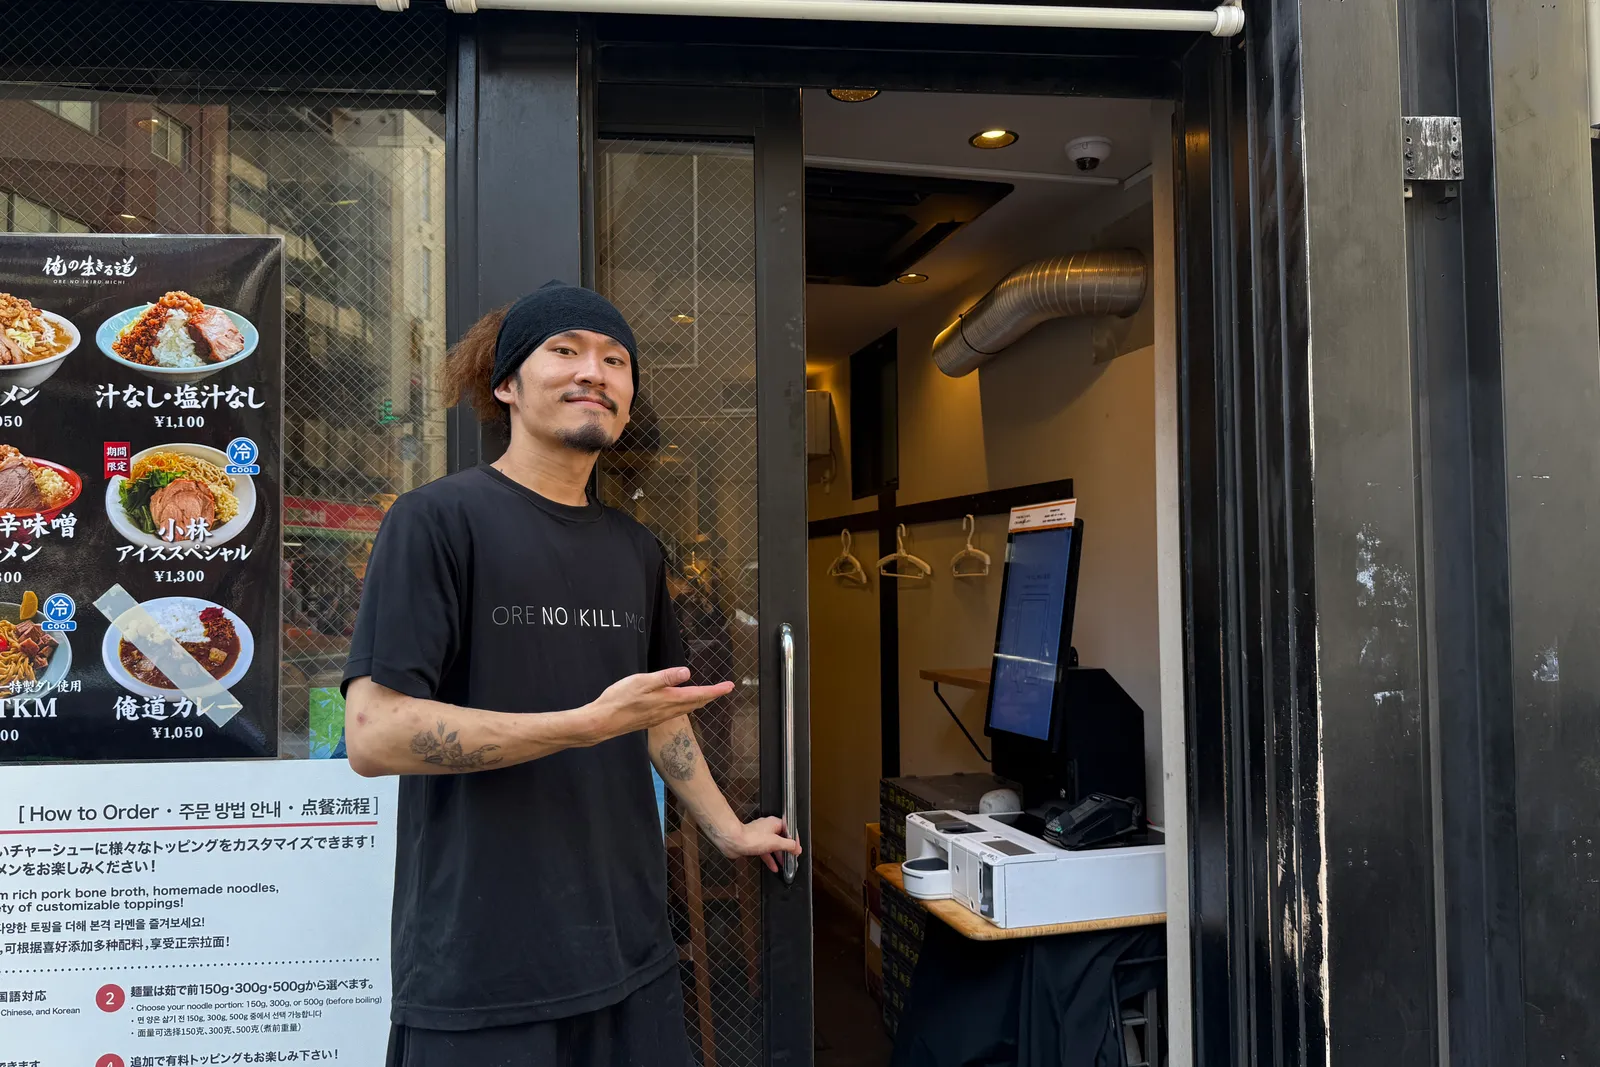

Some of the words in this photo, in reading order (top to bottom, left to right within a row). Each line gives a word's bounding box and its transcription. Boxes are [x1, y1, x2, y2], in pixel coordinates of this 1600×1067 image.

[42, 255, 137, 277] 俺の生きる道
[95, 383, 266, 410] 汁なし・塩汁なし
[154, 415, 205, 429] ¥1,100
[106, 446, 127, 457] 期間
[233, 442, 252, 461] 冷
[106, 461, 128, 472] 限定
[159, 518, 213, 543] 小林
[115, 544, 253, 563] アイススペシャル
[0, 571, 22, 583] 00
[154, 570, 205, 583] ¥1,300
[50, 599, 70, 617] 冷
[492, 606, 535, 625] ORE
[542, 606, 568, 626] NO
[112, 695, 243, 721] 俺道カレー
[151, 726, 204, 740] ¥1,050
[77, 806, 97, 821] to
[103, 804, 160, 820] Order
[179, 803, 211, 820] 주문
[215, 801, 245, 820] 방법
[250, 801, 281, 818] 안내
[12, 889, 37, 900] rich
[42, 888, 71, 901] pork
[75, 888, 107, 898] bone
[111, 886, 149, 898] broth,
[153, 884, 223, 896] homemade
[227, 883, 279, 894] noodles,
[0, 903, 14, 914] ty
[18, 902, 32, 912] of
[36, 900, 120, 912] customizable
[124, 898, 184, 910] toppings!
[30, 920, 62, 933] 토핑을
[65, 920, 86, 932] 더해
[90, 919, 110, 931] 본격
[114, 919, 146, 931] 라멘을
[149, 917, 205, 930] 즐겨보세요!
[0, 990, 47, 1002] 国語対応
[105, 992, 115, 1005] 2
[136, 1004, 165, 1012] Choose
[167, 1004, 185, 1012] your
[187, 1002, 213, 1010] noodle
[215, 1001, 244, 1010] portion:
[246, 1000, 268, 1008] 150g,
[270, 999, 291, 1007] 300g,
[303, 998, 324, 1006] 500g
[326, 997, 353, 1006] (before
[355, 996, 383, 1004] boiling)
[1, 1009, 34, 1017] Chinese,
[52, 1007, 80, 1015] Korean
[229, 1013, 248, 1021] 500g
[250, 1012, 270, 1020] 중에서
[272, 1011, 286, 1020] 선택
[288, 1010, 322, 1019] 가능합니다
